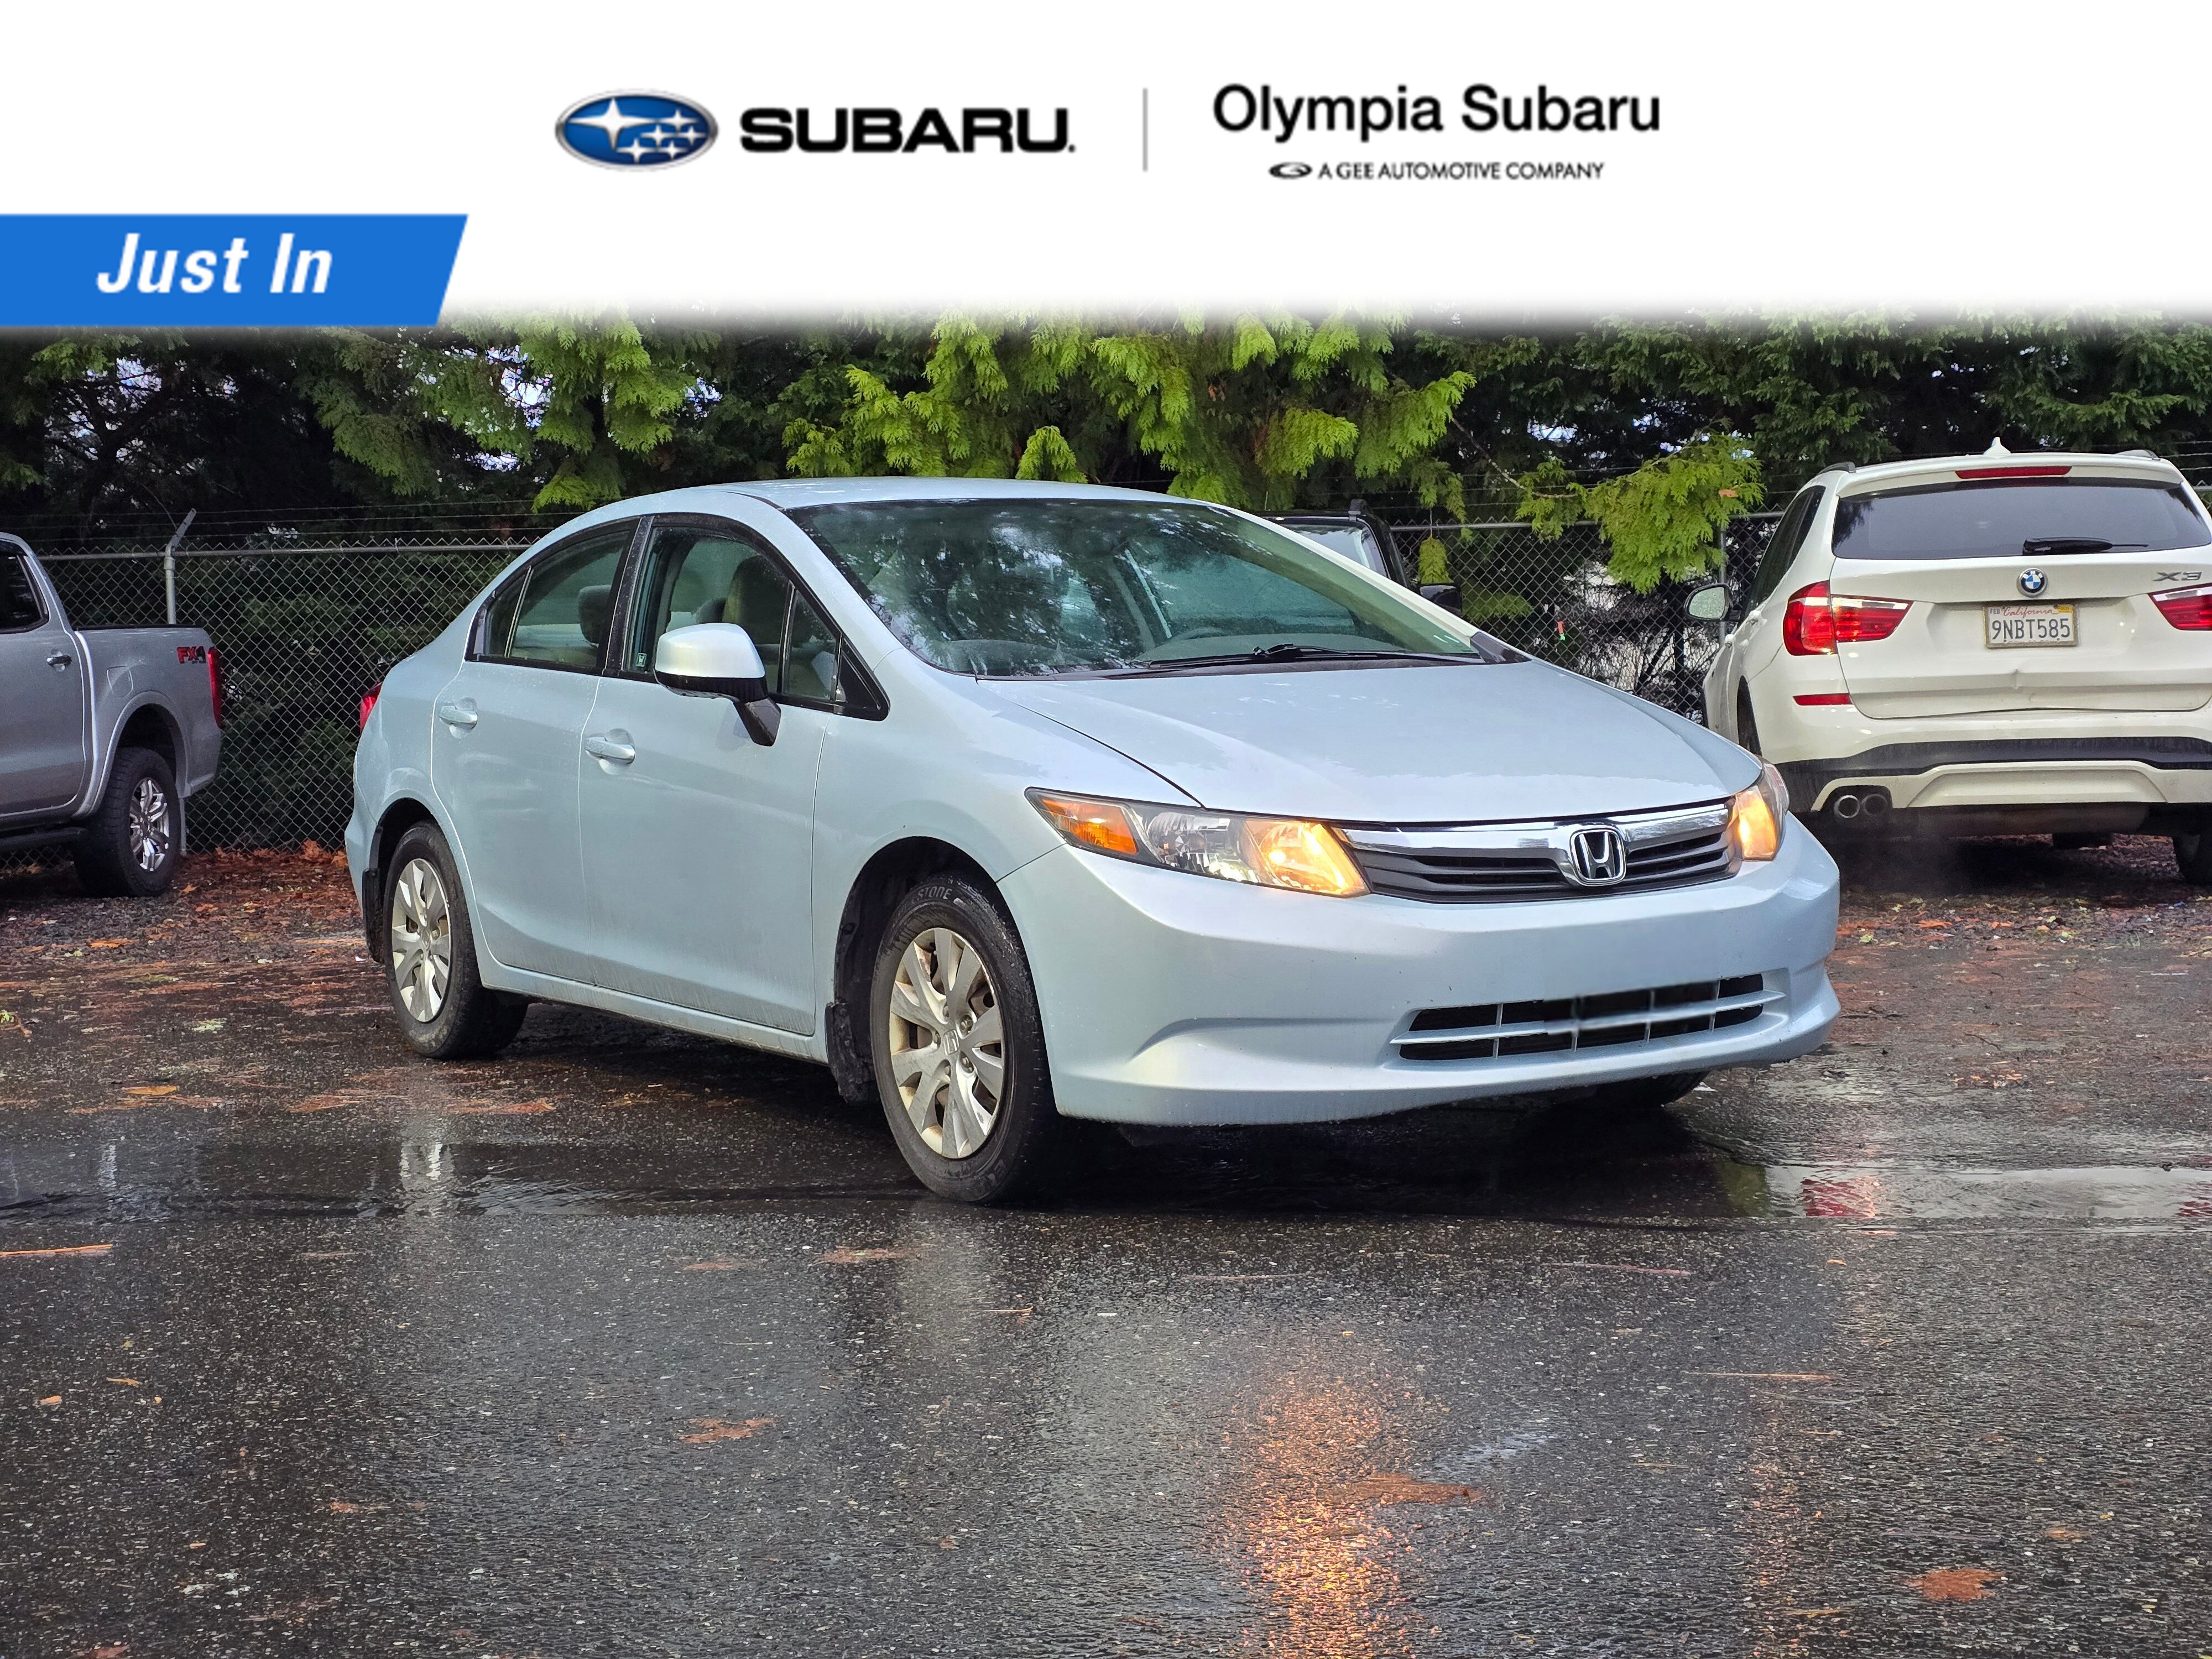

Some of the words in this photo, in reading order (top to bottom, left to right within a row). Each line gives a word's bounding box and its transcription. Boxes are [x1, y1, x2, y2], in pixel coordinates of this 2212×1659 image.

[2153, 571, 2202, 581] X3
[2003, 606, 2058, 618] California
[1992, 618, 2070, 639] 9NBT585
[177, 646, 206, 664] FX4
